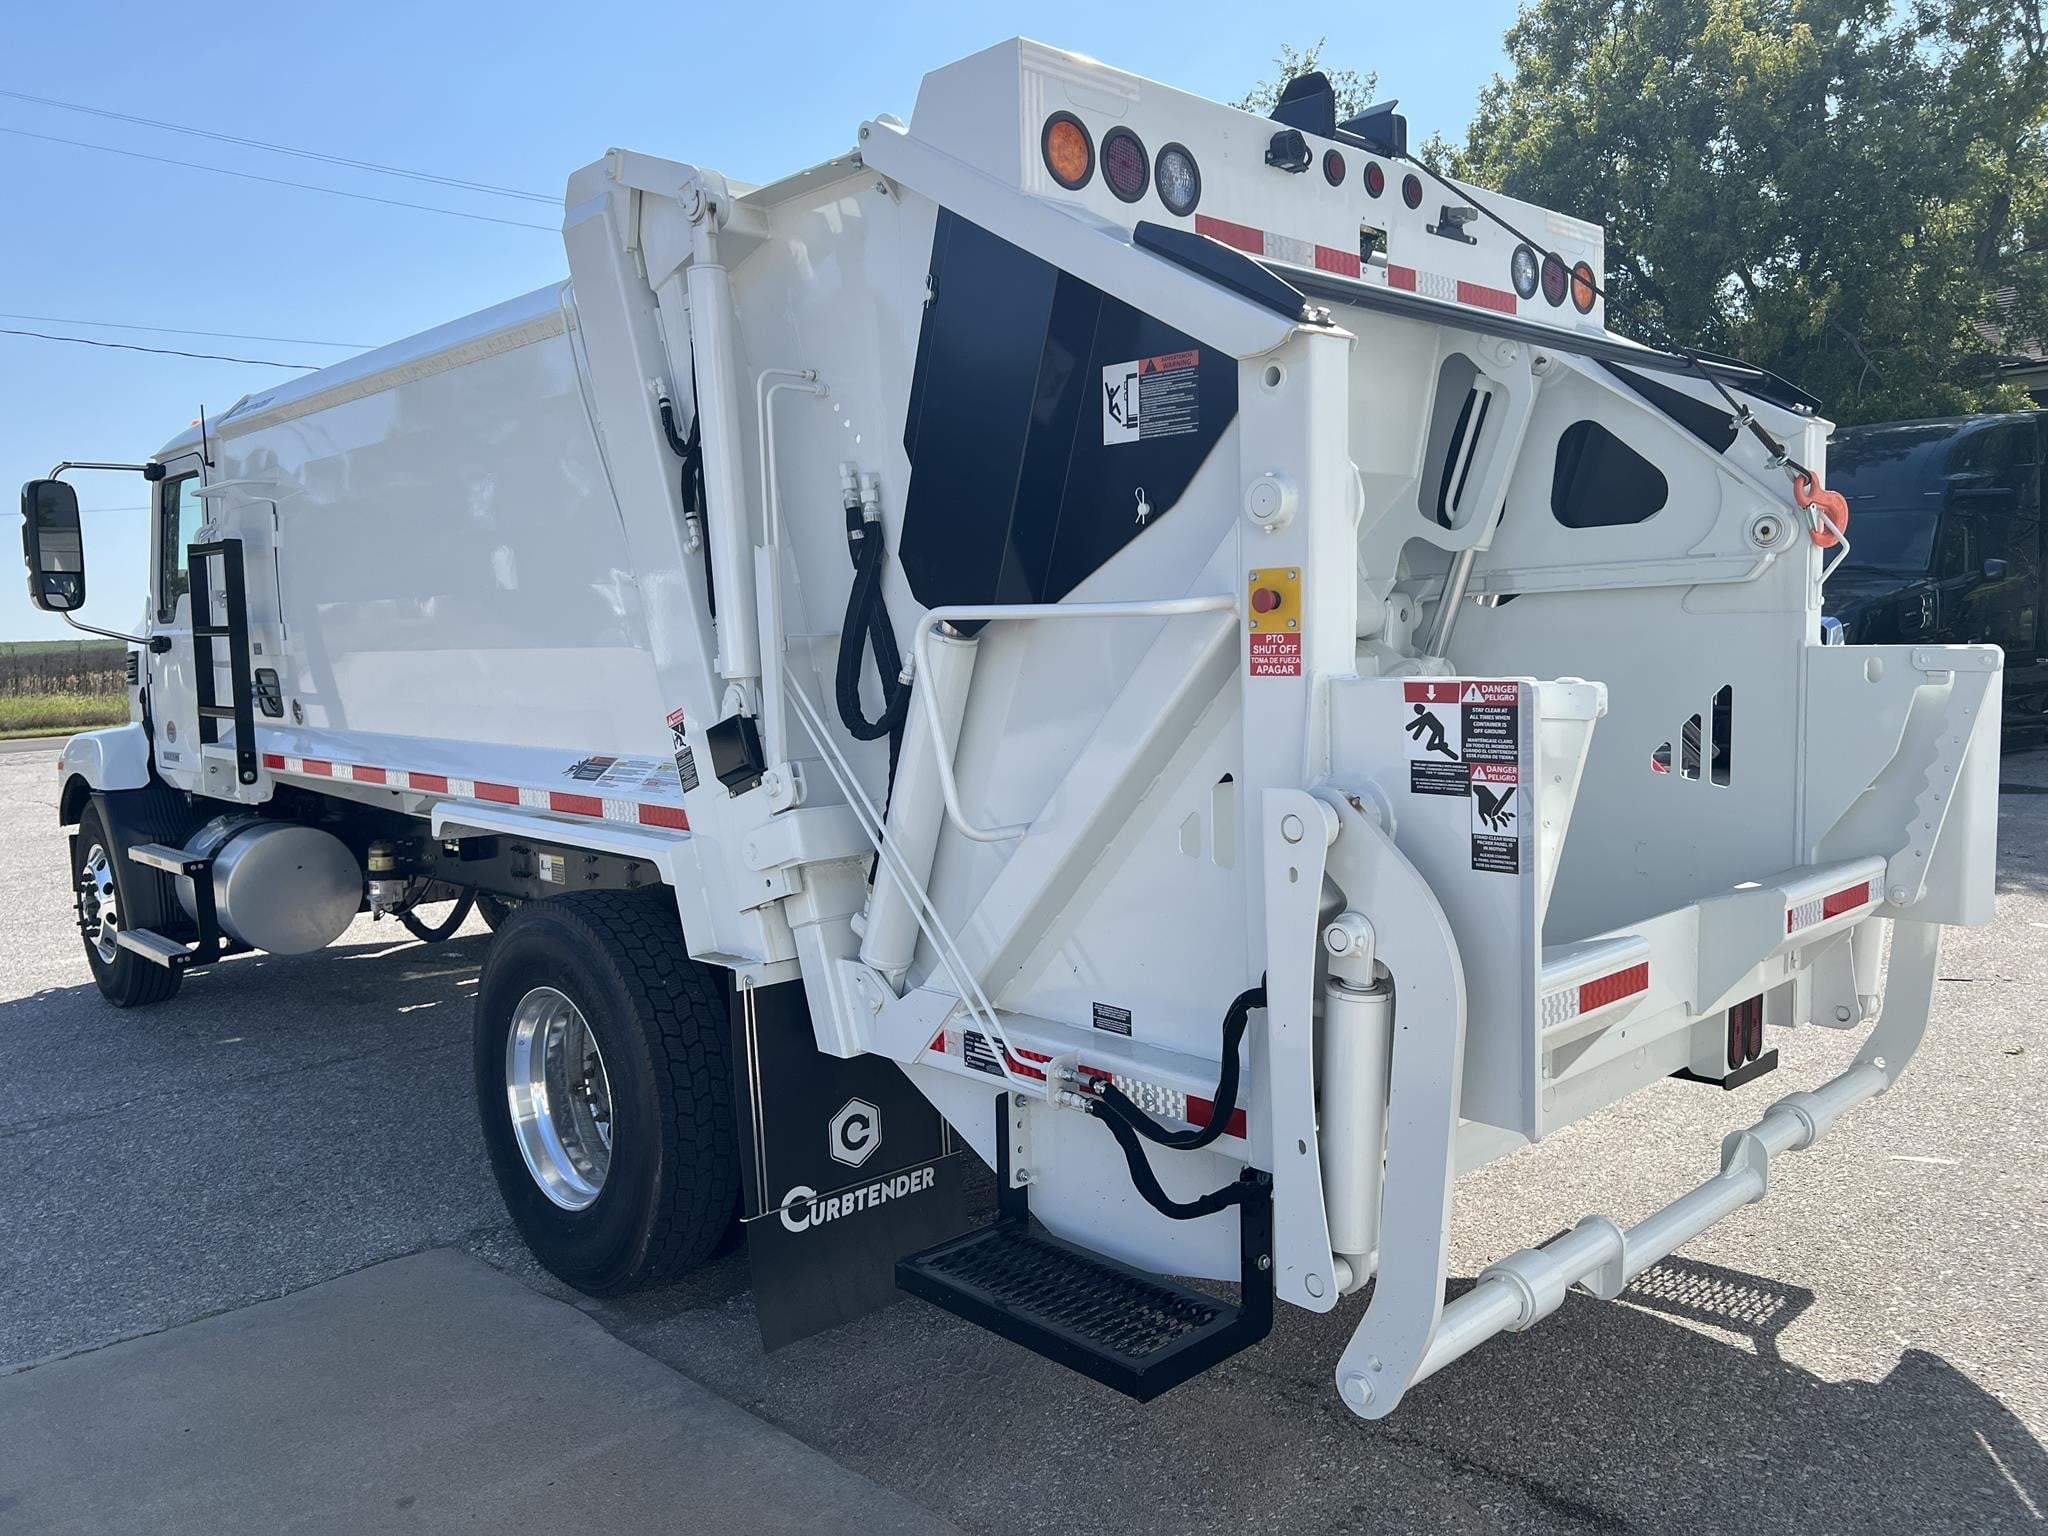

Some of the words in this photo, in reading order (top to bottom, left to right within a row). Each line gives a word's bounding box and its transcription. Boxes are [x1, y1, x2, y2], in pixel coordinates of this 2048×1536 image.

[1162, 359, 1192, 368] WARNING
[1266, 635, 1284, 644] PTO
[1253, 645, 1277, 654] SHUT
[1279, 645, 1298, 654] OFF
[1256, 665, 1294, 674] APAGAR
[1482, 685, 1518, 694] DANGER
[1486, 766, 1518, 774] DANGER
[1488, 774, 1516, 782] PELIGRO
[841, 1114, 870, 1150] C
[780, 1166, 934, 1232] CURBTENDER
